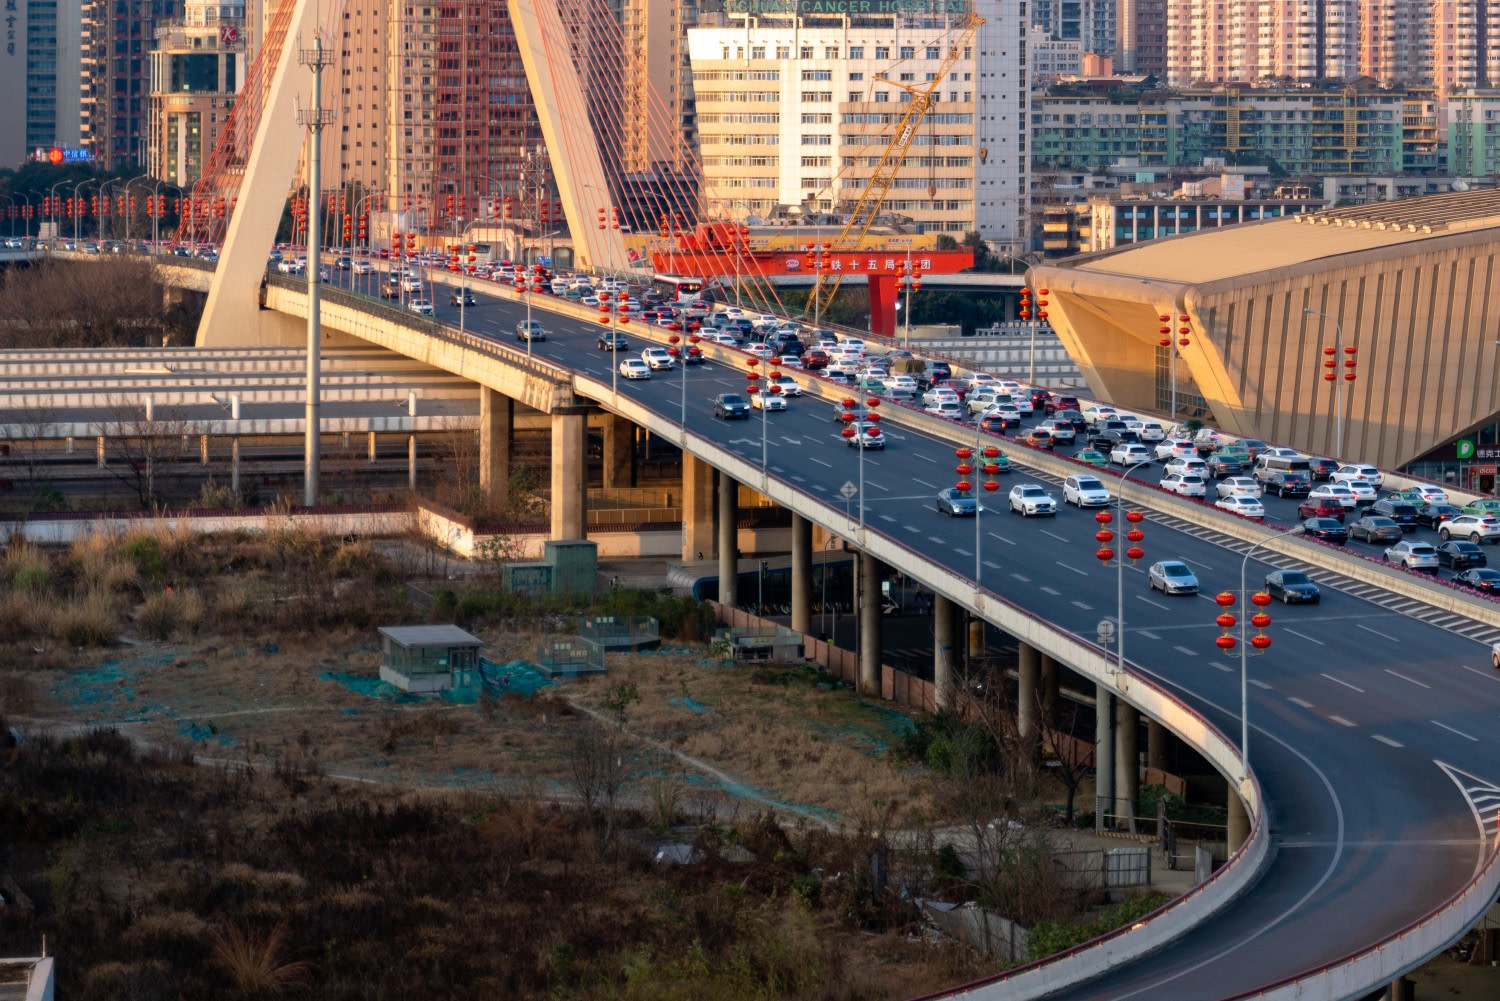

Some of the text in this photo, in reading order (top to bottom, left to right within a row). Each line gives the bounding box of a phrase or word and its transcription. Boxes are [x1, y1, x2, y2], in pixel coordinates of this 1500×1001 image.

[722, 0, 968, 13] SICHUAN CANCER HOSPITAL
[814, 259, 931, 271] 中铁十五局集团
